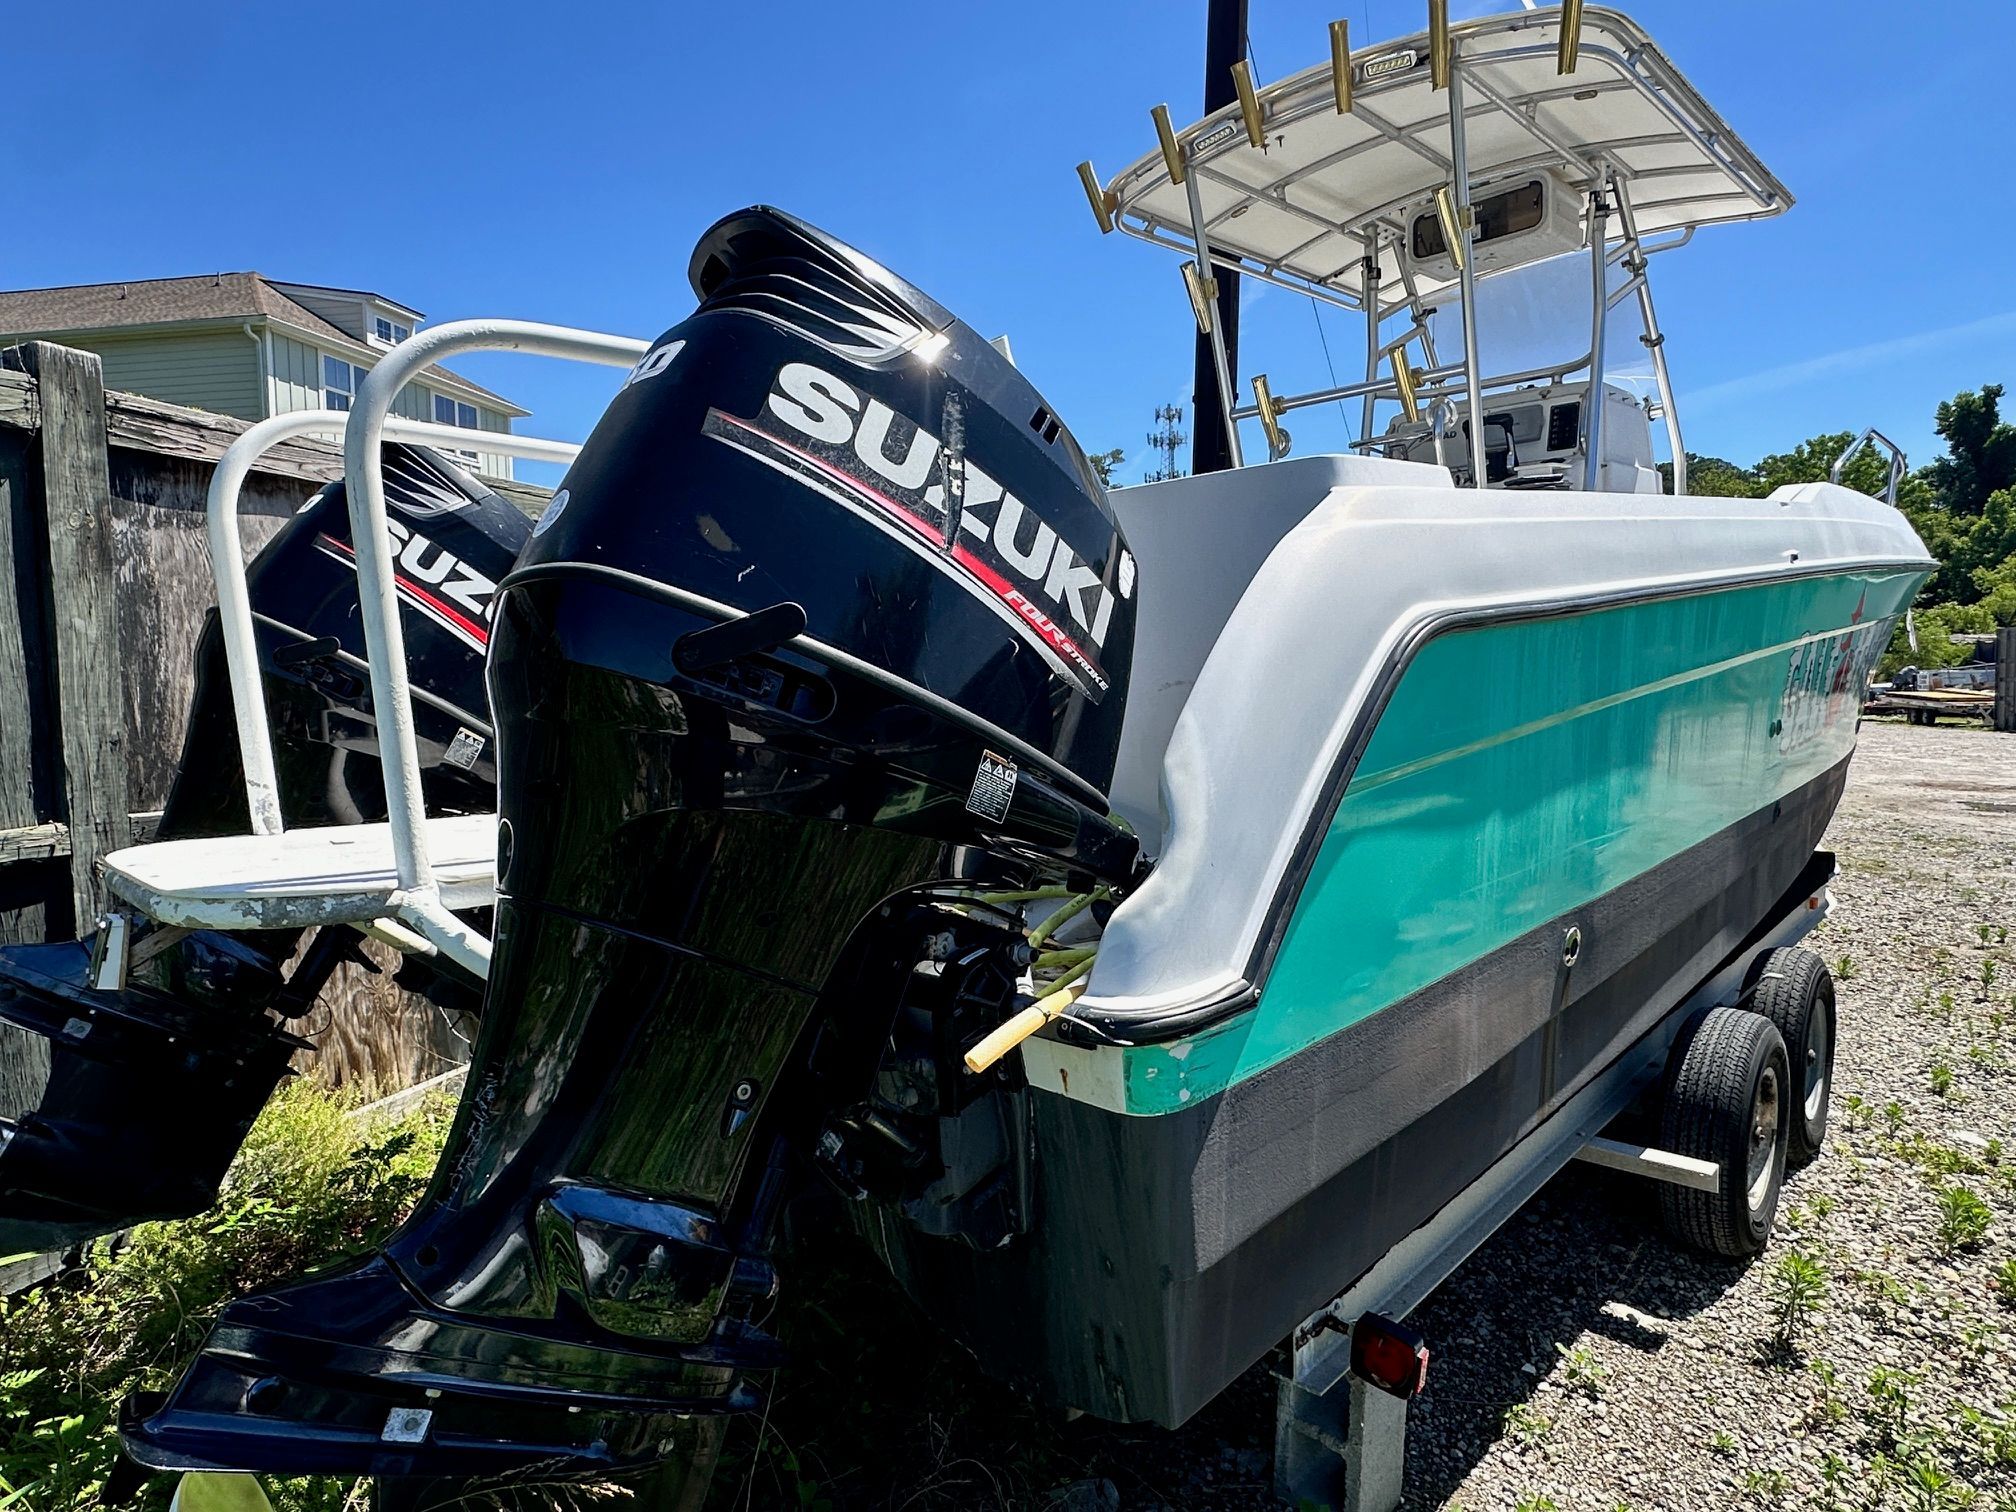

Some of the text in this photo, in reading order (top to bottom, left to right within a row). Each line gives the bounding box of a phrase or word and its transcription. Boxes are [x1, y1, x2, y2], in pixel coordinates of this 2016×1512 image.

[769, 363, 1114, 648] SUZUKI
[1004, 589, 1109, 691] FOUR STROKE
